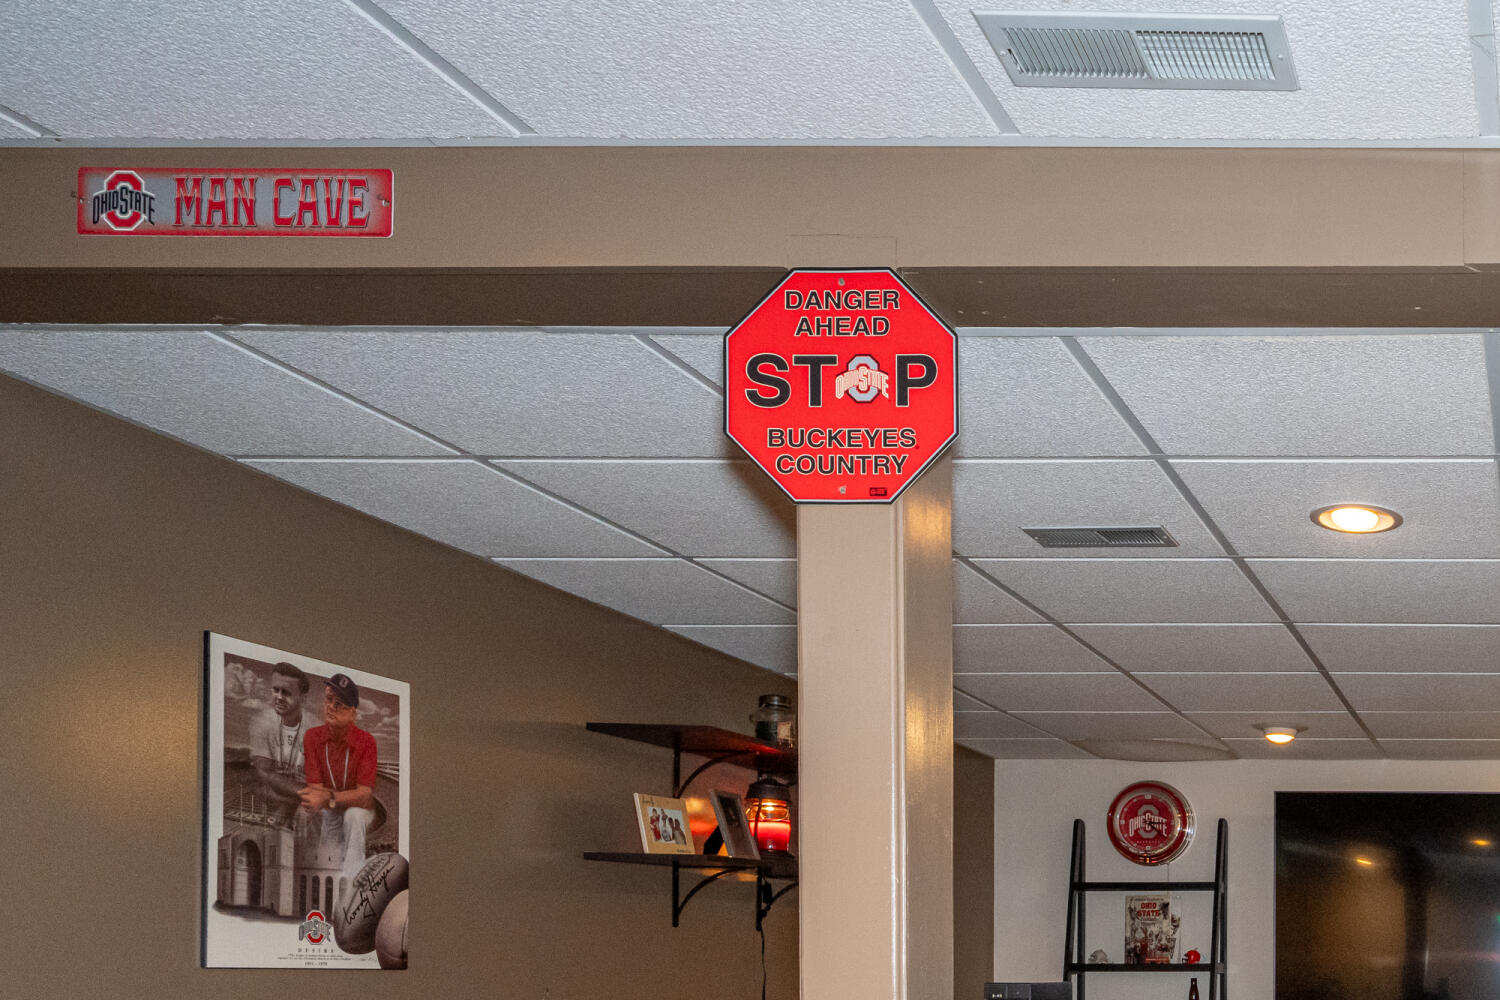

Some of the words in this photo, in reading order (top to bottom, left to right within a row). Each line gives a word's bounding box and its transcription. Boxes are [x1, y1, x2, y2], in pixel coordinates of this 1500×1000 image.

[172, 175, 257, 228] MAN
[272, 175, 371, 229] CAVE
[784, 289, 901, 310] DANGER
[794, 316, 890, 337] AHEAD
[767, 427, 917, 449] BUCKEYES
[775, 453, 908, 475] COUNTRY
